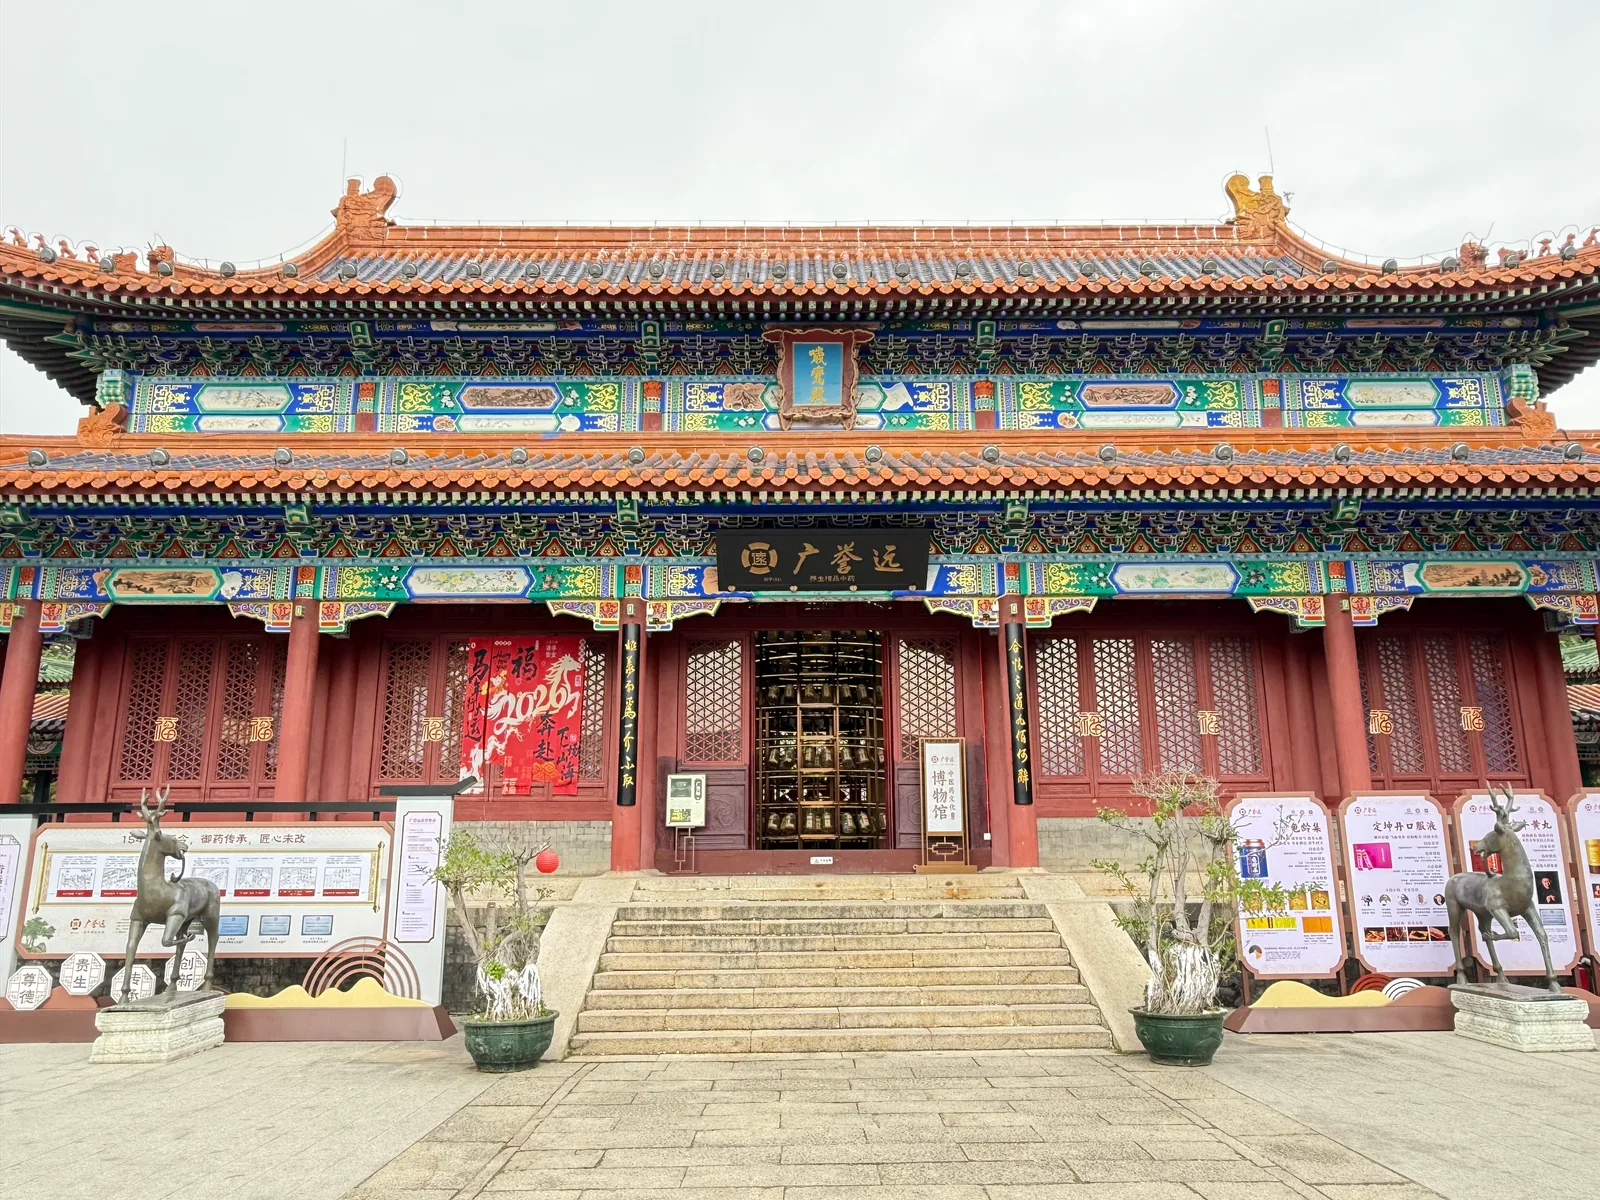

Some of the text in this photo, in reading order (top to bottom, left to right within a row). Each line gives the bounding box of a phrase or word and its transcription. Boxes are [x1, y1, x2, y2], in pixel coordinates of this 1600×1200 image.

[792, 541, 904, 575] 广誉远
[511, 646, 538, 681] 福
[534, 711, 556, 762] 奔赴
[931, 769, 949, 820] 博物馆
[1290, 821, 1321, 833] 龟龄集
[1372, 820, 1437, 832] 定坤丹口服液
[19, 972, 38, 1005] 尊德
[72, 958, 91, 989] 贵生
[177, 956, 195, 988] 创新
